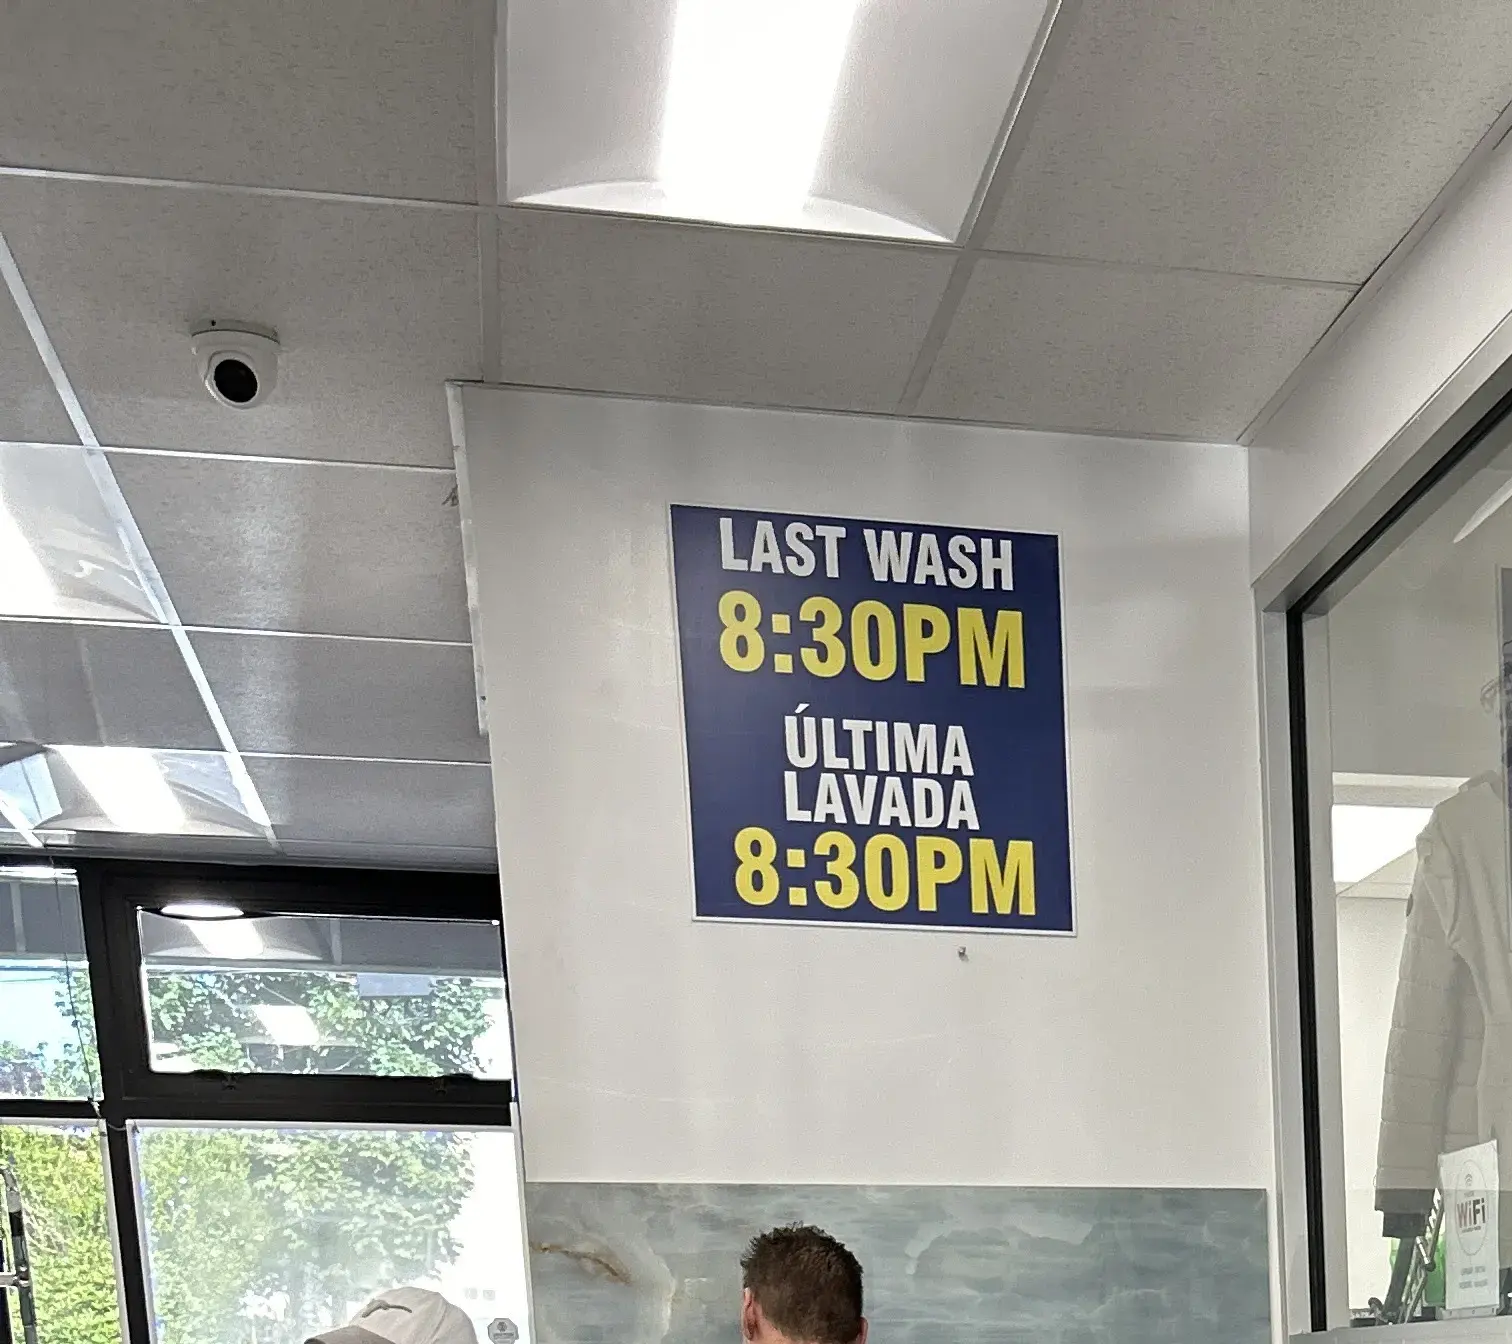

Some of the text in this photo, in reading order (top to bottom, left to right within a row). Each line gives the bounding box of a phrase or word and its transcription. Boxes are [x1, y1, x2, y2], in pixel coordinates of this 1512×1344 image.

[718, 516, 1014, 591] LAST WASH
[717, 589, 1026, 689] 8:30PM
[783, 703, 974, 776] ÚLTIMA
[783, 770, 981, 831] LAVADA
[733, 826, 1037, 916] 8:30PM
[1456, 1197, 1486, 1228] WiFi
